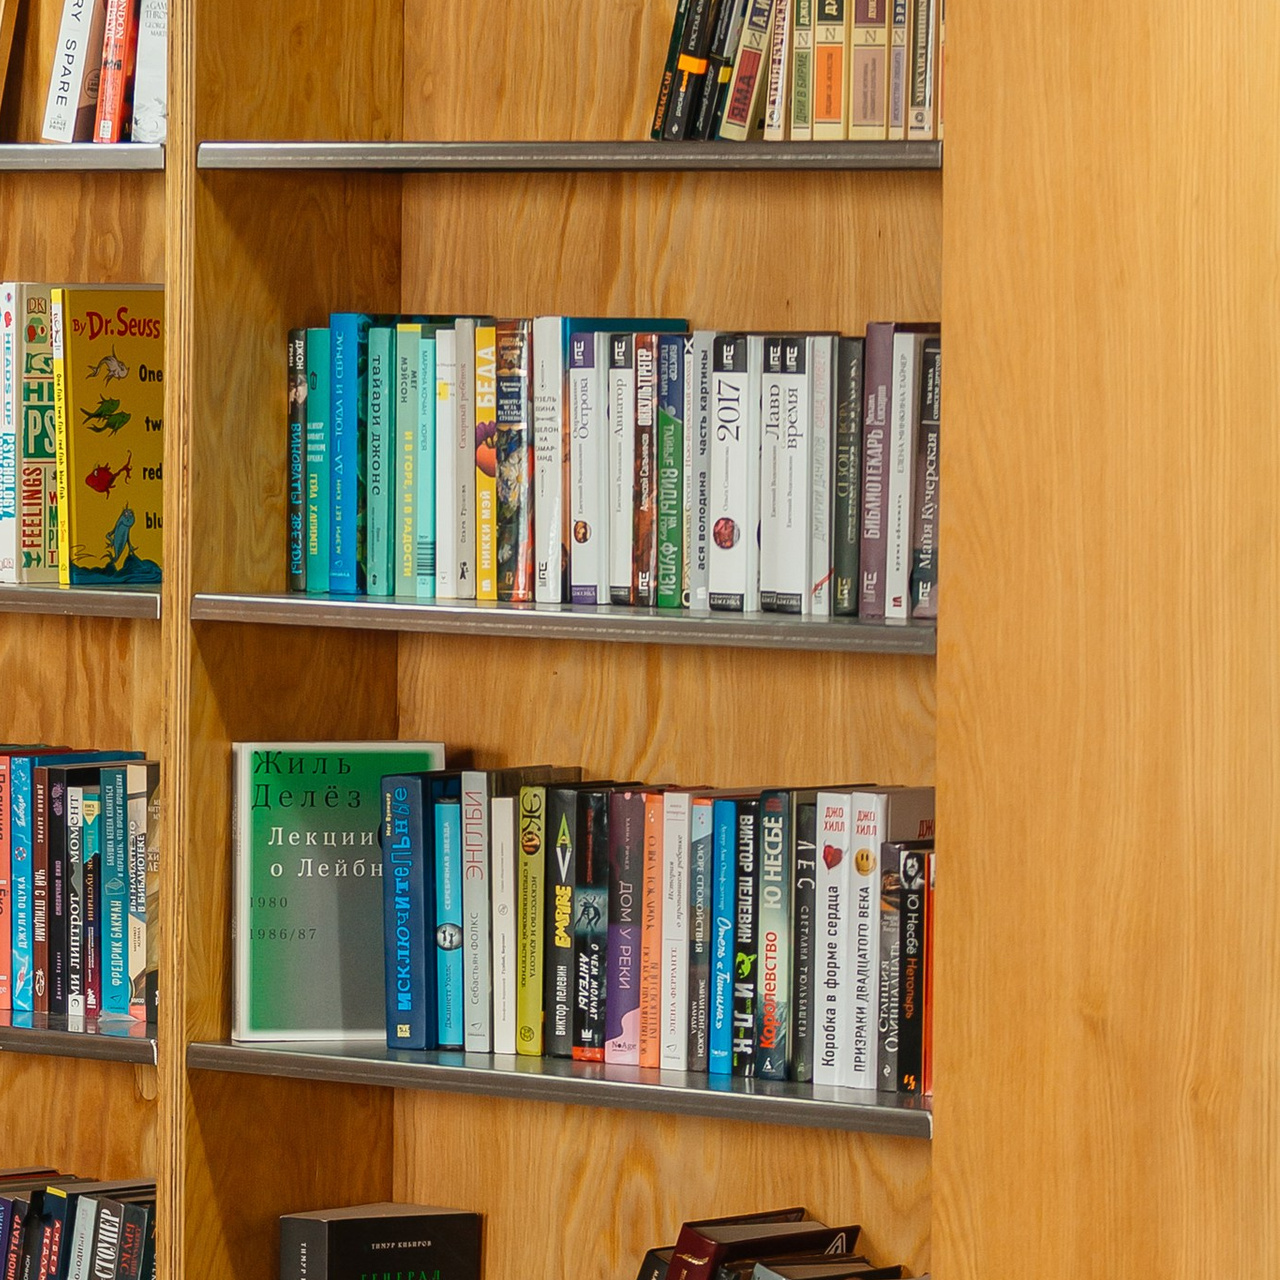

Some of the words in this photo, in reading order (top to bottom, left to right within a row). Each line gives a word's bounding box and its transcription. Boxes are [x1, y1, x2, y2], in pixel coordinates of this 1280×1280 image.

[56, 39, 76, 107] SPARE
[728, 75, 753, 119] ЯМА
[72, 319, 85, 336] By
[86, 312, 116, 340] Dr.
[117, 307, 161, 340] Seuss
[4, 332, 12, 387] HEADS
[139, 364, 163, 382] One
[477, 346, 494, 408] БЕДА
[699, 350, 708, 411] картины
[370, 355, 382, 426] тайари
[717, 379, 741, 442] 2017
[5, 404, 12, 423] UP
[699, 415, 707, 455] часть
[290, 423, 301, 504] ВИНОВАТЫ
[369, 432, 382, 495] джонс
[663, 425, 675, 466] ТАЙНЫЕ
[3, 435, 15, 513] PSYCHOLOGY
[660, 468, 678, 515] ВИДЫ
[864, 429, 883, 539] БИБЛИОТЕКАРЬ
[481, 491, 491, 519] МЭЙ
[667, 516, 676, 529] НА
[697, 471, 706, 541] володина
[291, 513, 302, 574] ЗВЕЗДЫ
[482, 524, 491, 568] НИККИ
[659, 516, 667, 541] ГОРУ
[659, 543, 677, 595] ФУДЗИ
[253, 751, 352, 775] Жиль
[251, 784, 362, 810] Делёз
[268, 826, 373, 847] Лекции
[465, 791, 483, 880] ЭНГЛБИ
[34, 869, 45, 887] ЧАЙ
[271, 864, 283, 877] о
[298, 858, 383, 878] Лейбн
[34, 901, 45, 942] ПТИЦАМИ
[110, 900, 123, 938] БАКМАН
[619, 881, 632, 922] ДОМ
[827, 885, 840, 936] сердца
[906, 893, 918, 910] Ю
[619, 928, 631, 940] У
[905, 913, 919, 954] Несбё
[111, 940, 124, 986] ФРЕДРИК
[618, 946, 631, 989] РЕКИ
[825, 942, 840, 989] форме
[904, 957, 918, 1019] Нетопырь
[821, 1006, 836, 1067] Коробка
[11, 1215, 22, 1251] ТЕАТР
[94, 1209, 120, 1279] СТОУНЕР
